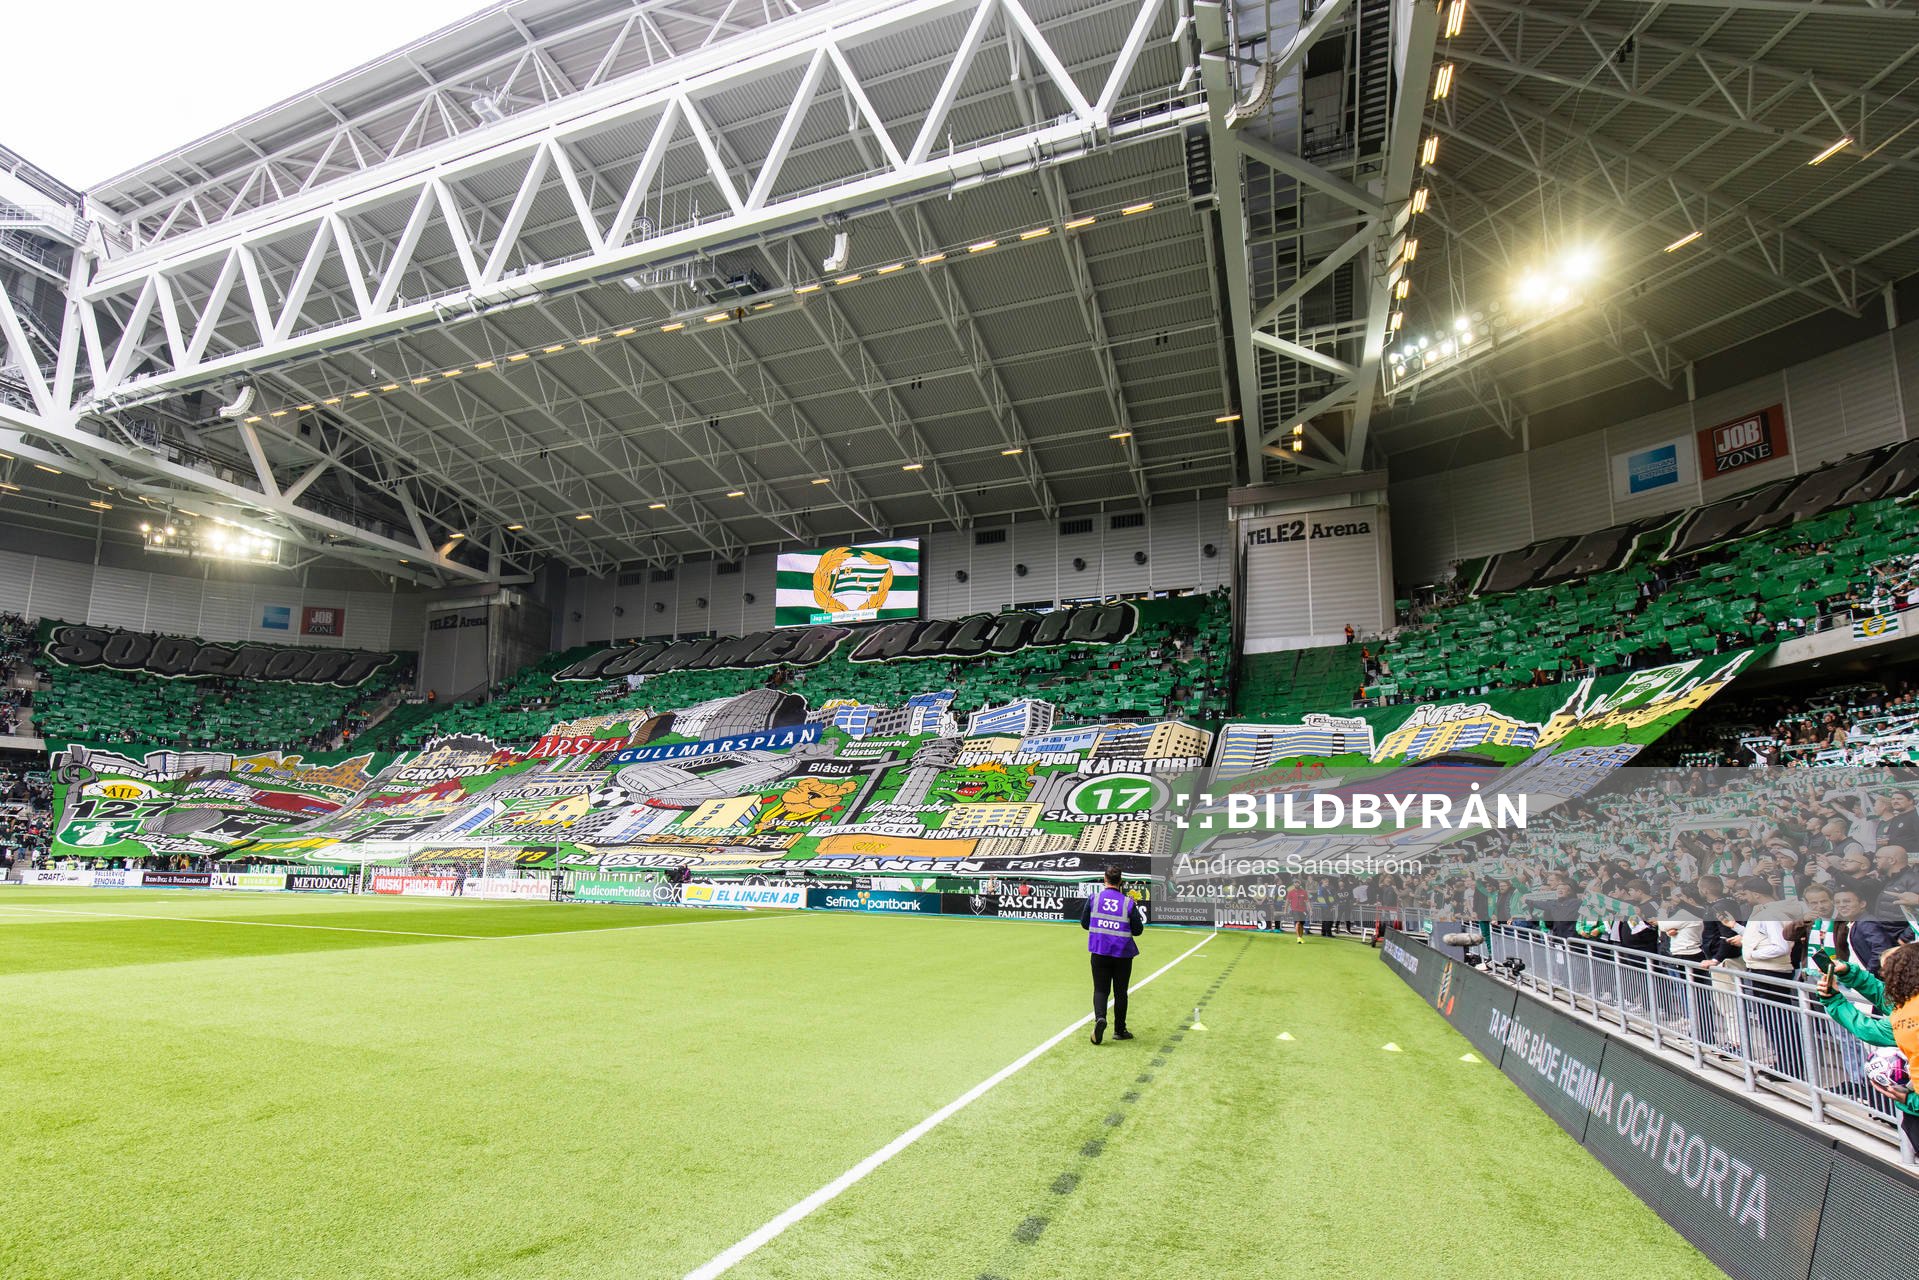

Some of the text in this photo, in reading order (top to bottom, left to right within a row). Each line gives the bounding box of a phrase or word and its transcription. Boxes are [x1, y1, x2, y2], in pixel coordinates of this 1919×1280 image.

[1718, 420, 1760, 453] JOB
[1717, 443, 1771, 472] ZONE
[1248, 520, 1370, 545] TELE2 Arena
[311, 611, 333, 624] JOB
[309, 625, 335, 633] ZONE
[528, 737, 624, 759] ÅRSTA
[617, 727, 816, 763] GULLMARSPLAN
[846, 740, 910, 749] Hammarby
[958, 751, 1080, 767] Björkhagen
[1078, 757, 1203, 773] KÄRRTORP
[398, 762, 500, 781] GRÖNDAL
[808, 763, 854, 774] Blåsut
[89, 783, 154, 800] SÄTRA
[1093, 788, 1150, 810] 17
[70, 799, 177, 820] 127
[661, 823, 752, 837] BANDHAGEN
[768, 817, 833, 828] SVEDMYRA
[816, 823, 920, 835] TALLKROGEN
[924, 827, 1044, 839] HÖKARÄNGEN
[760, 856, 984, 873] GUBBÄNGEN
[1007, 855, 1082, 869] Farsta
[38, 873, 60, 881] CRAFT
[578, 884, 651, 898] AudicomPendax
[717, 890, 800, 904] EL LINJEN AB
[826, 896, 921, 911] Sefina pantbank
[998, 895, 1064, 910] SASCHAS
[1102, 898, 1119, 912] 33
[998, 910, 1064, 920] FAMILJEARBETE
[1216, 908, 1267, 930] DICKENS
[1097, 919, 1120, 929] FOTO
[1489, 1007, 1500, 1039] TA
[1528, 1033, 1562, 1083] BÅDE
[1557, 1054, 1615, 1125] HEMMA
[1617, 1092, 1664, 1160] OCH
[1663, 1121, 1768, 1240] BORTA
